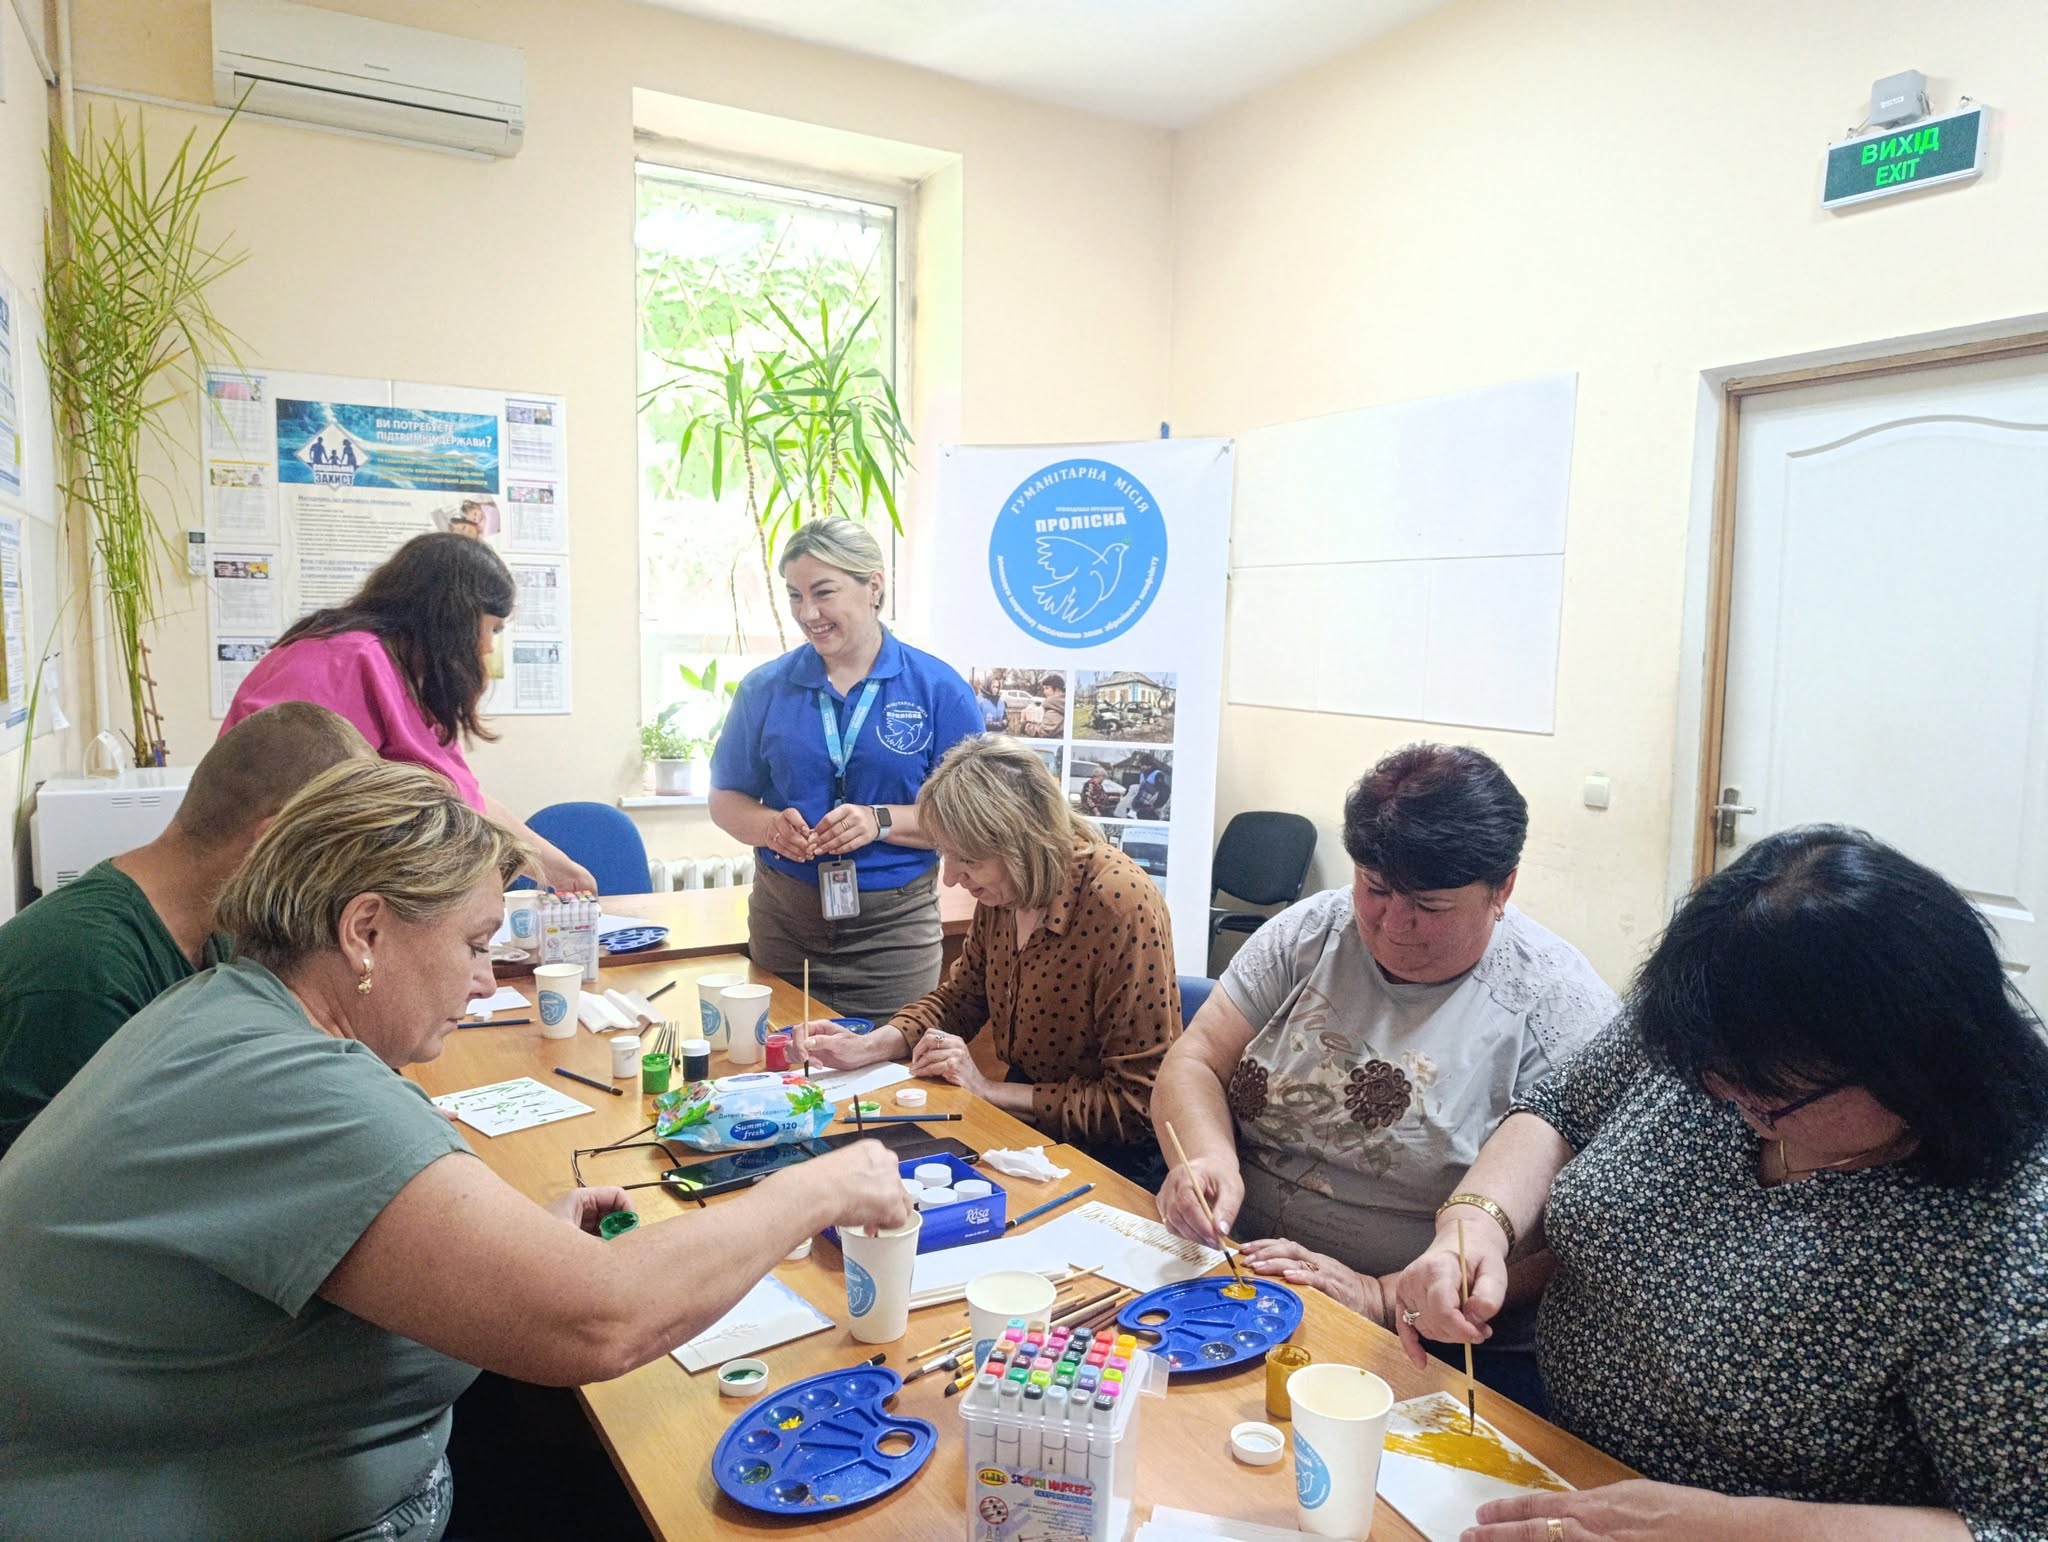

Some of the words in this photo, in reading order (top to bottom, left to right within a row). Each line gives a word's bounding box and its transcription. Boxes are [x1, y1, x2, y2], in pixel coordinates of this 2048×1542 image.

[1861, 127, 1940, 165] ВИХІД
[1875, 158, 1920, 187] EXIT
[376, 418, 391, 429] ВИ
[393, 420, 455, 433] ПОТРЕБУЄТЕ
[439, 434, 492, 448] ДЕРЖАВИ?
[315, 473, 353, 486] ЗАХИСТ
[1010, 467, 1107, 515] ГУМАНІТАРНА
[1114, 477, 1150, 513] МІСІЯ
[1035, 511, 1127, 533] ПРОЛІСКА
[735, 1121, 770, 1133] Summer
[782, 1122, 798, 1130] 120
[742, 1129, 765, 1140] fresh
[1011, 1473, 1046, 1490] SKETCH
[1048, 1479, 1093, 1497] MARKERS
